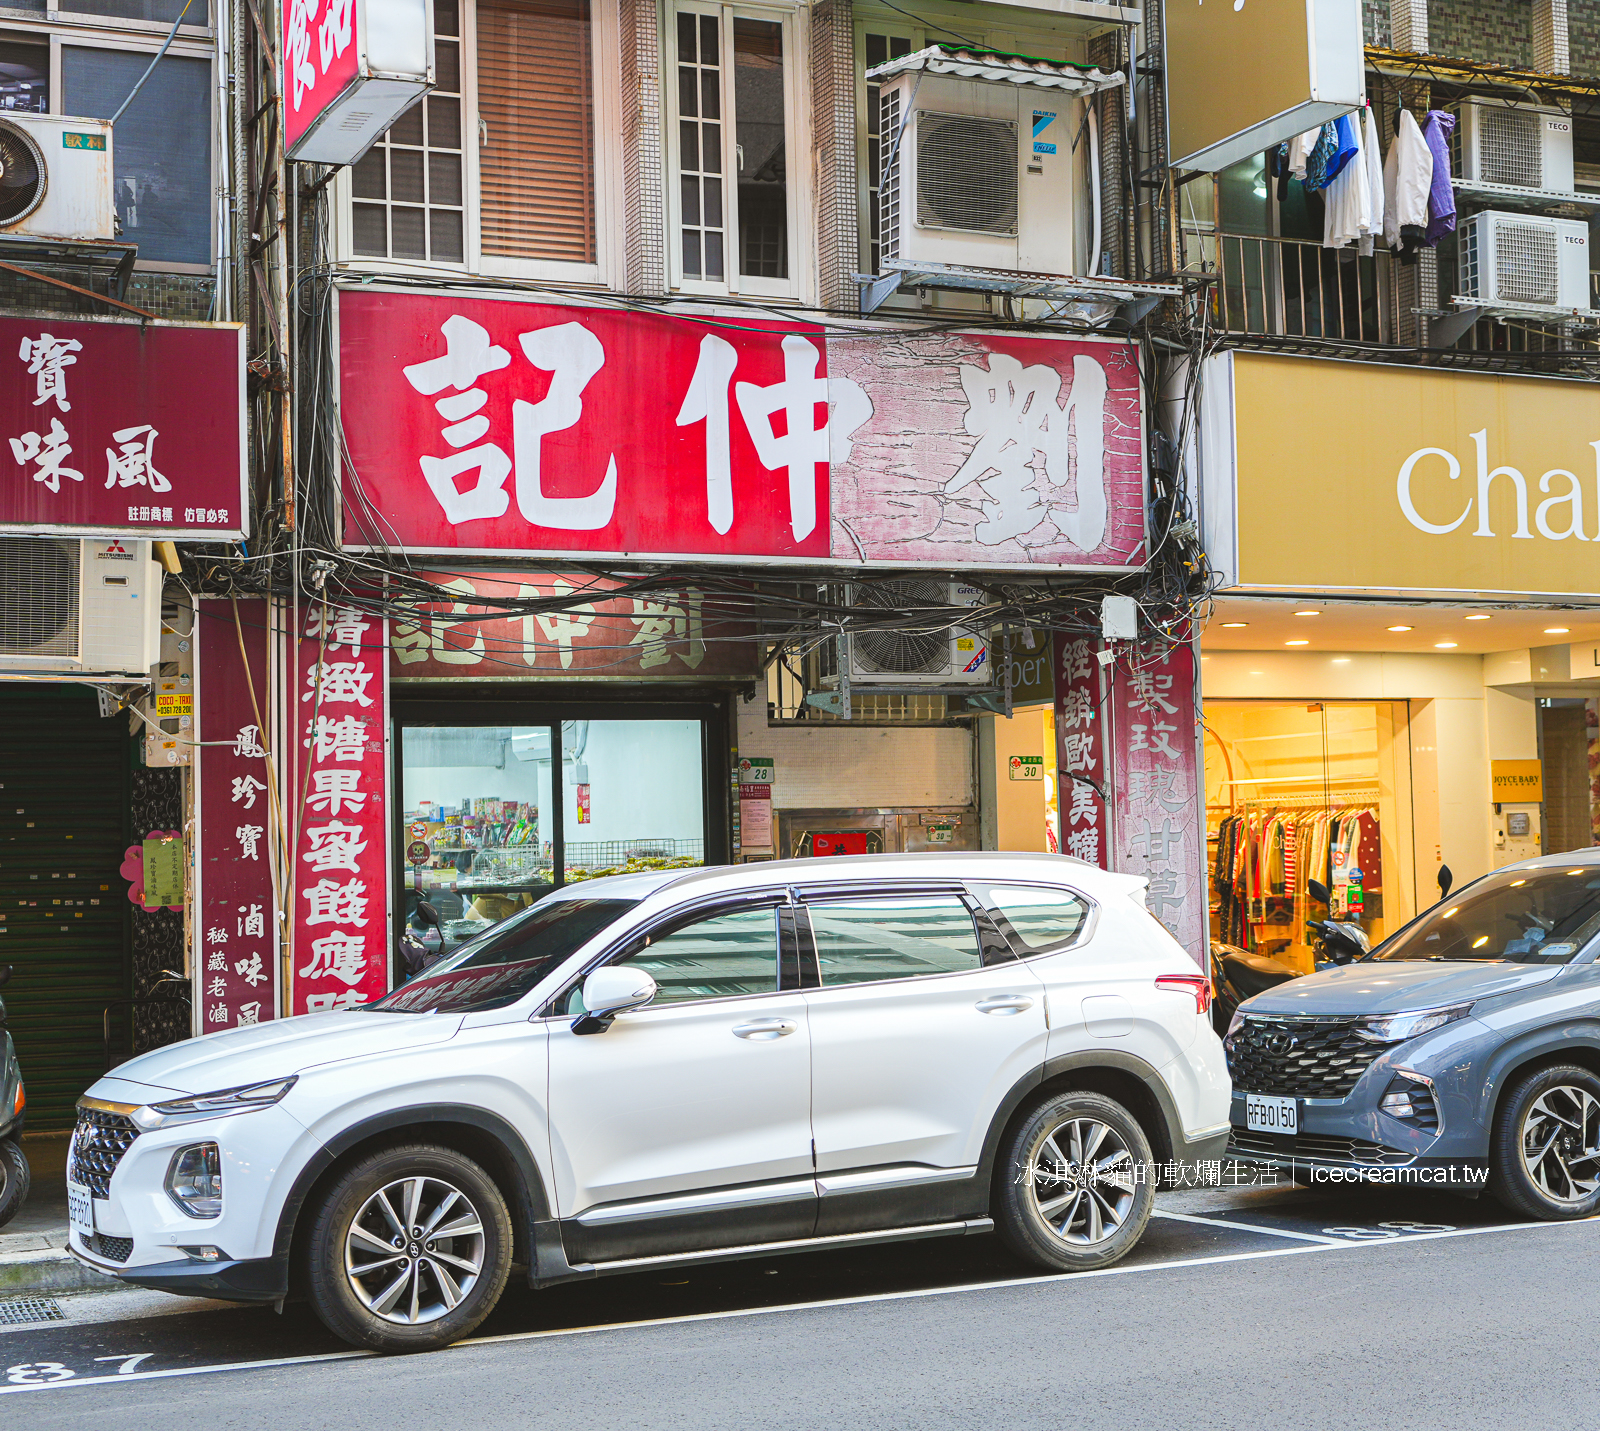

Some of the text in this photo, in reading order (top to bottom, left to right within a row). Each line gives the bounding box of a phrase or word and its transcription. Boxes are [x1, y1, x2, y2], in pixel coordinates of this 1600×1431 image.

[1033, 109, 1057, 118] DAIKIN
[1548, 122, 1568, 131] TECO
[1564, 236, 1585, 245] TECO
[19, 332, 83, 412] 寶
[957, 587, 981, 595] GREE
[159, 696, 174, 706] COCO
[173, 705, 182, 714] 728
[755, 768, 768, 780] 28
[1024, 766, 1037, 777] 30
[1494, 775, 1540, 783] JOYCE BABY
[935, 832, 945, 840] 30
